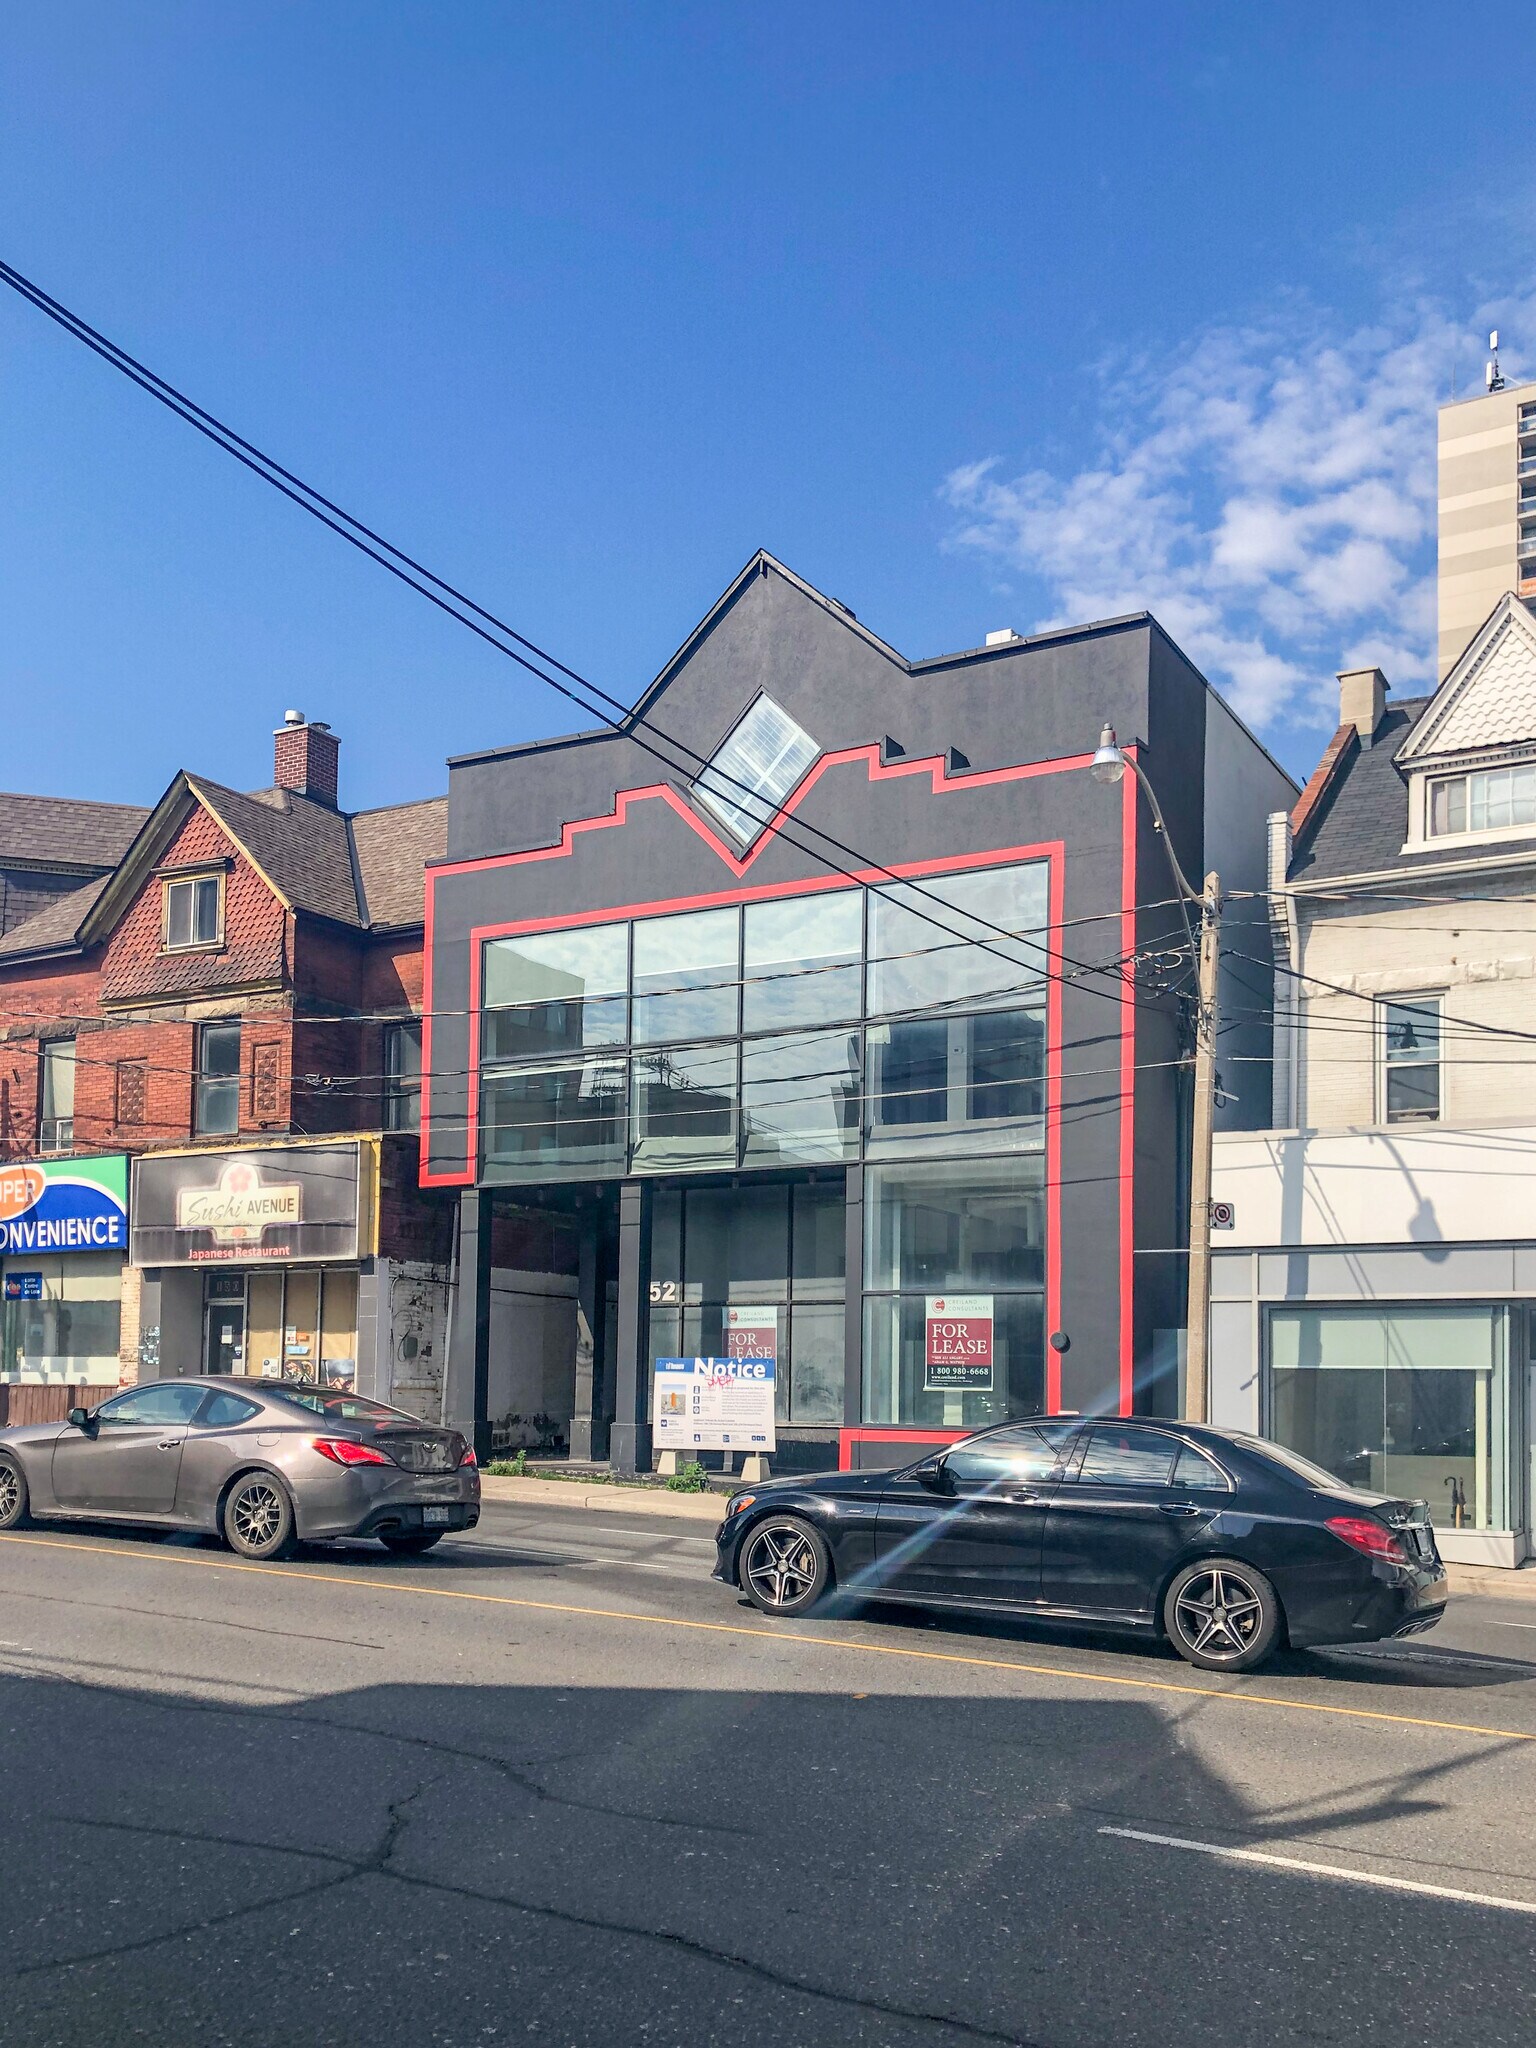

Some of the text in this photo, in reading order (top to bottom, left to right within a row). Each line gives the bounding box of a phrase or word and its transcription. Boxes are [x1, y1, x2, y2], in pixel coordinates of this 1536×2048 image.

[187, 1196, 295, 1226] Sushi AVENUE
[188, 1246, 290, 1261] Japanese Restaurant
[932, 1324, 969, 1338] FOR
[728, 1333, 757, 1346] FOR
[728, 1346, 773, 1359] LEASE
[932, 1340, 988, 1354] LEASE
[694, 1357, 766, 1378] Notice
[936, 1367, 951, 1375] 800
[952, 1367, 989, 1375] 980-6668
